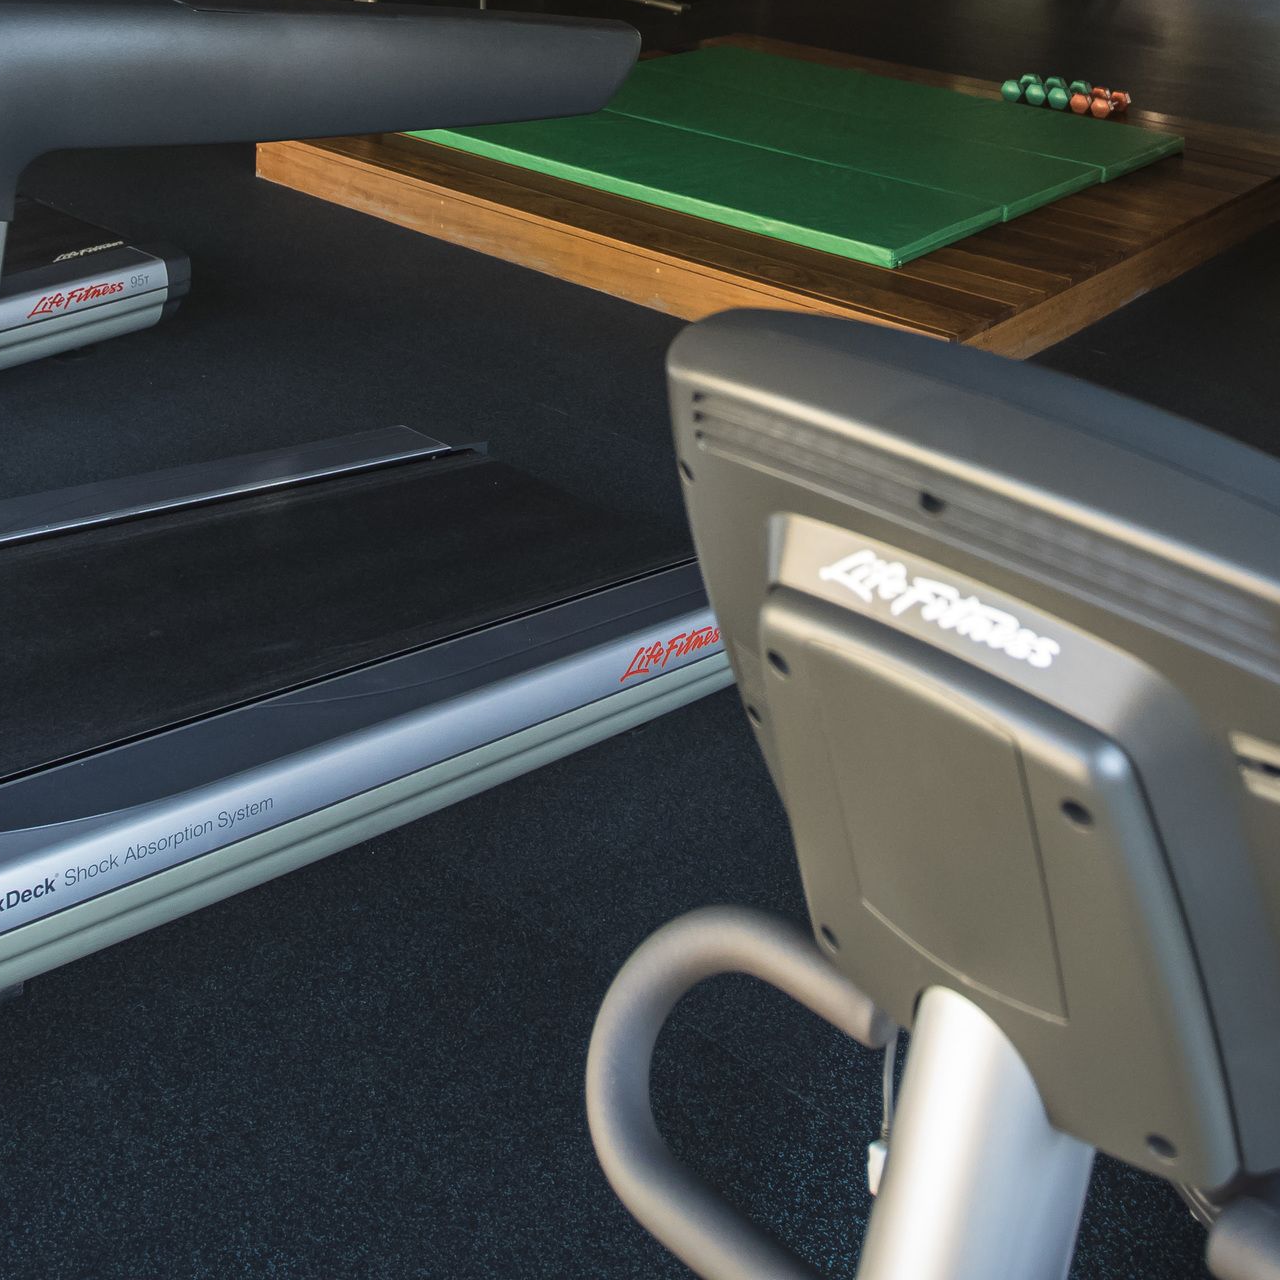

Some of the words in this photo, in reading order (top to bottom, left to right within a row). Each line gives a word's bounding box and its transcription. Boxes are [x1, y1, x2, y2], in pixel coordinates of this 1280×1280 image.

[661, 626, 720, 669] Fitnes
[65, 853, 119, 887] Shock
[124, 819, 213, 864] Absorption
[218, 797, 274, 829] System
